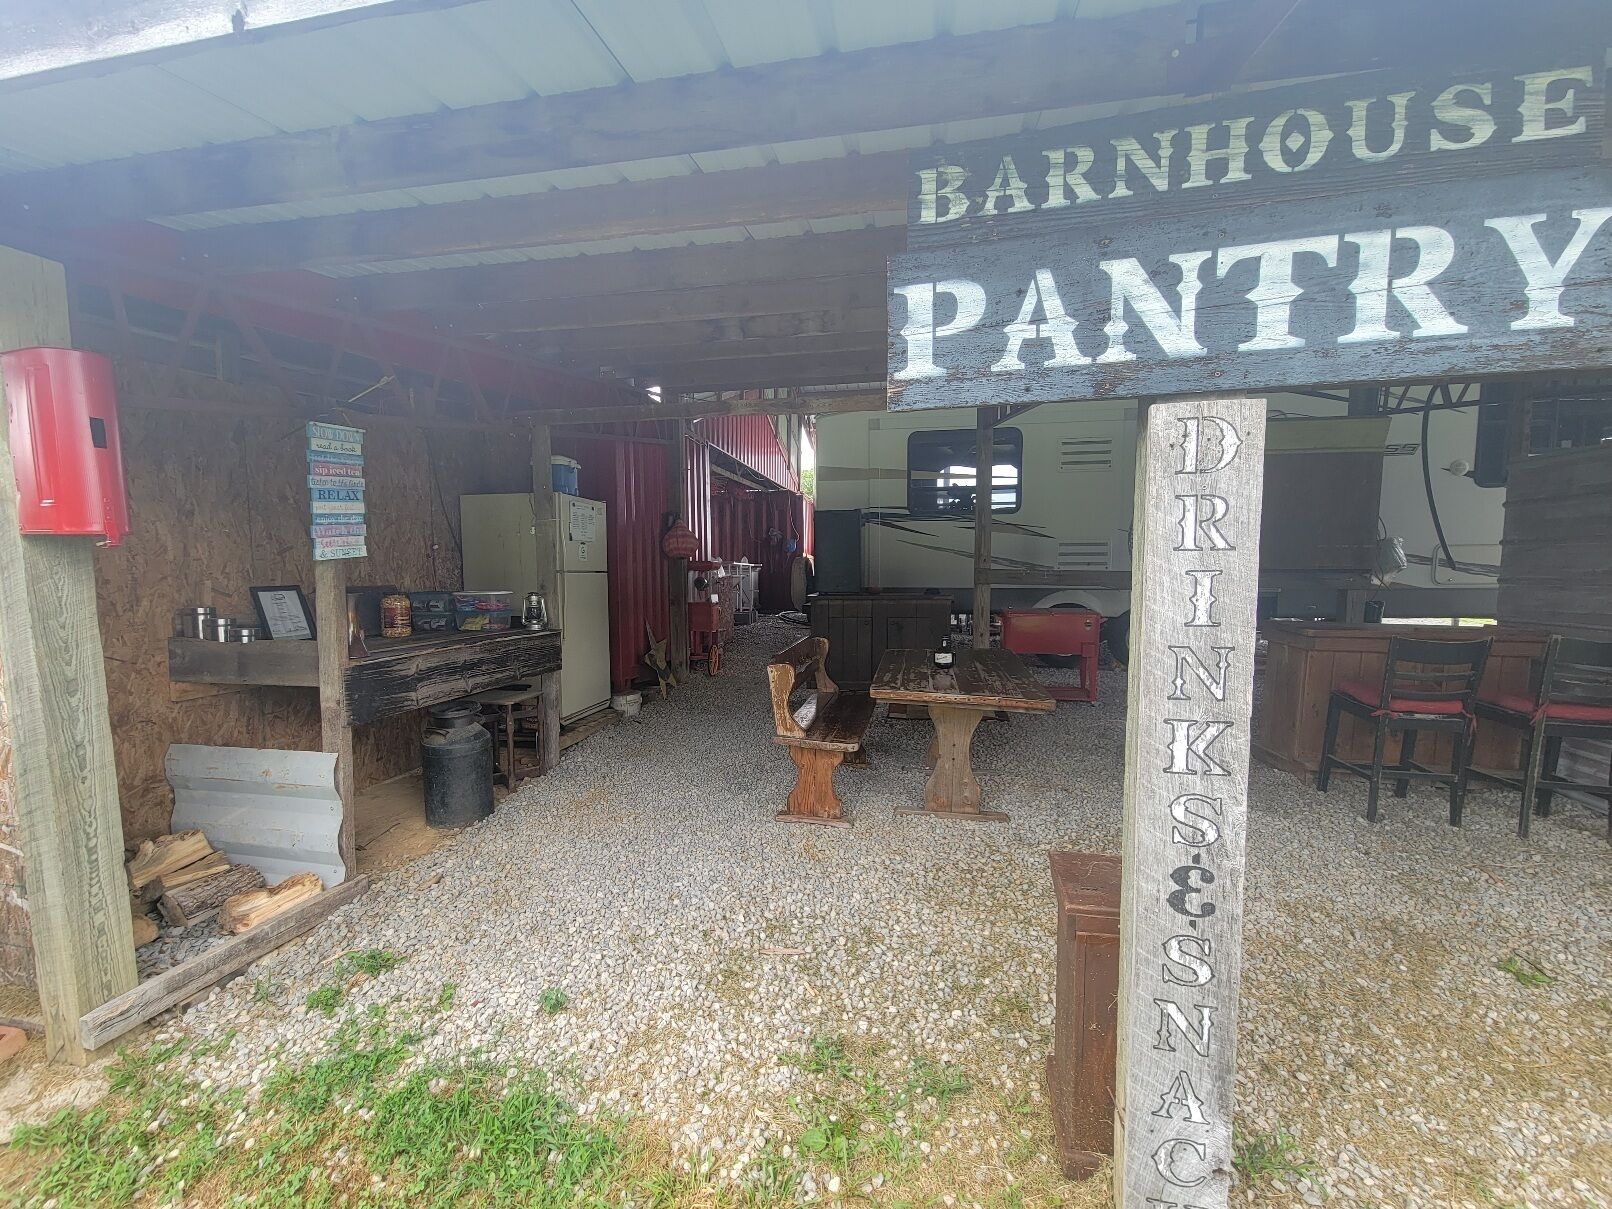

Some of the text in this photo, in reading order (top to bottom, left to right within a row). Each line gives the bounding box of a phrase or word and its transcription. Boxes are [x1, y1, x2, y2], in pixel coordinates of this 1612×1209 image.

[915, 65, 1594, 225] BARNHOUSE
[892, 206, 1612, 381] PANTRY
[315, 465, 360, 476] sip iced tea
[316, 442, 332, 450] read
[340, 444, 357, 453] book
[317, 489, 360, 501] RELAX
[1163, 416, 1244, 848] DRINKS
[1146, 934, 1219, 1209] SNAC
